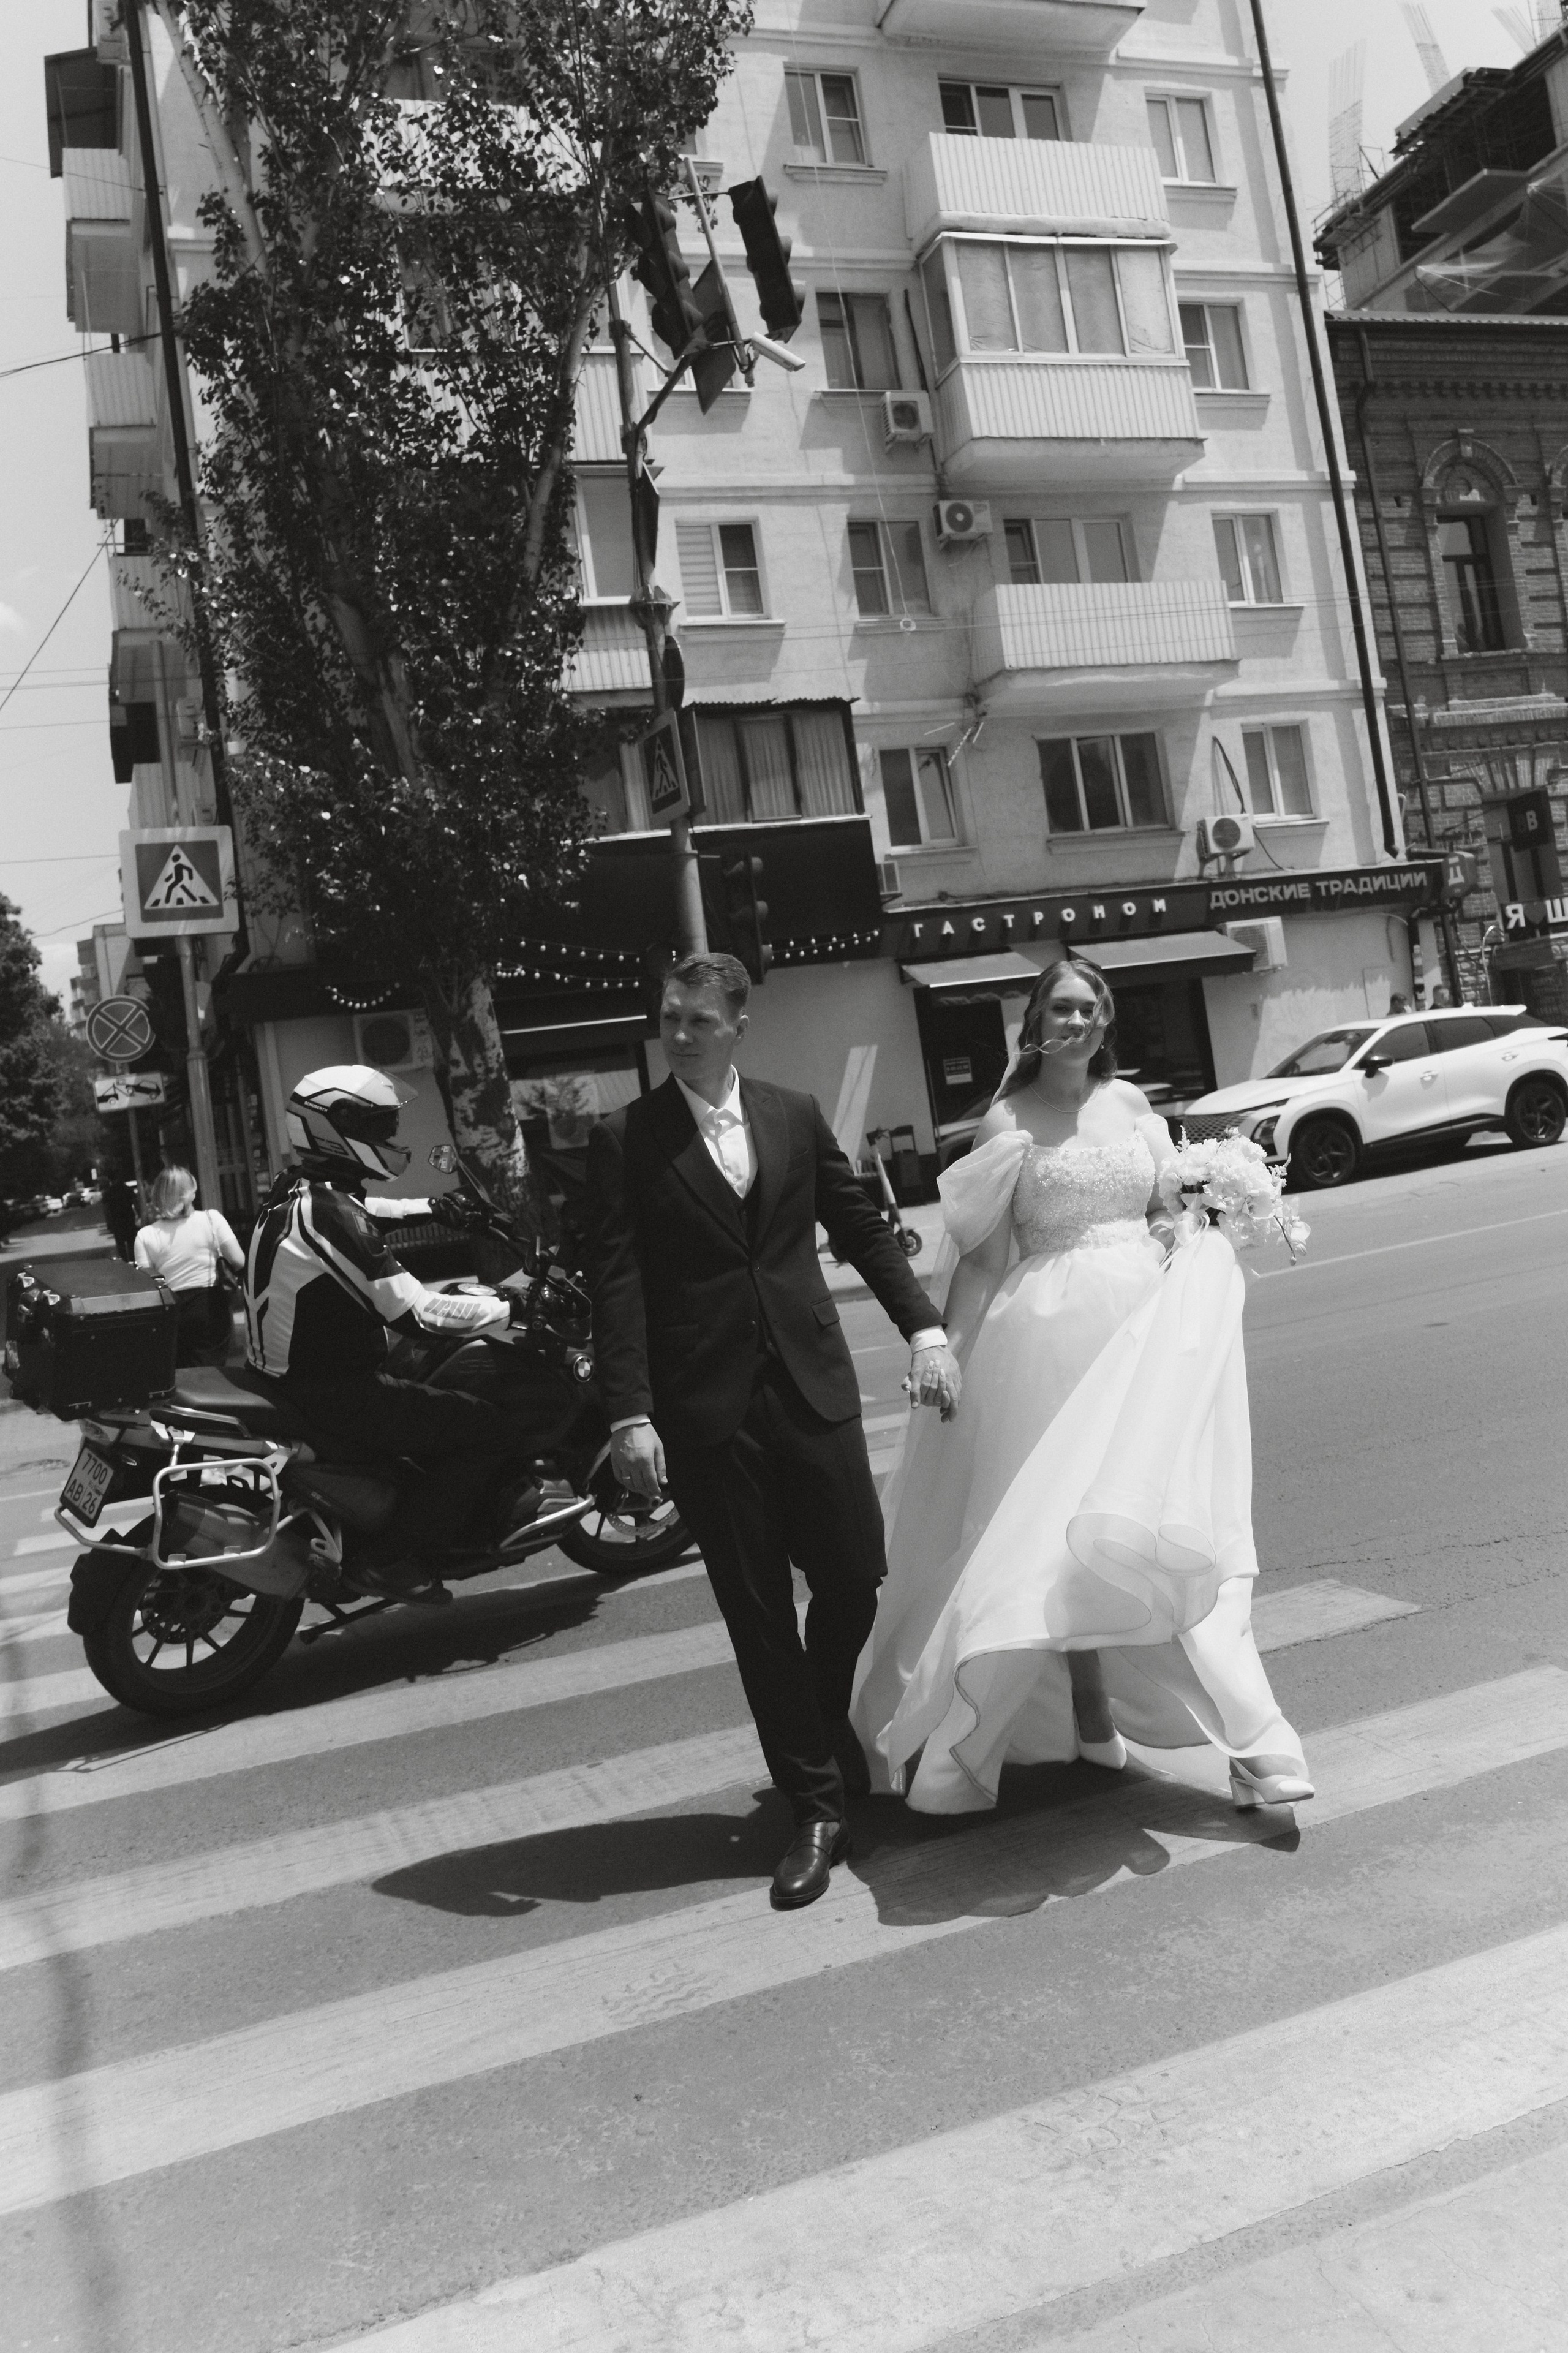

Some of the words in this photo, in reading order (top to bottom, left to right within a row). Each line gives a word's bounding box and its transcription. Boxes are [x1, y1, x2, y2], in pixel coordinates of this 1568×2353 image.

[1210, 882, 1311, 910] ДОНСКИЕ
[1316, 872, 1427, 897] ТРАДИЦИИ
[913, 899, 1166, 937] ГАСТРОНОМ
[1505, 903, 1526, 930] Я
[304, 1101, 328, 1112] SCHUBERTH
[82, 1454, 108, 1484] 7700
[83, 1493, 97, 1514] 26
